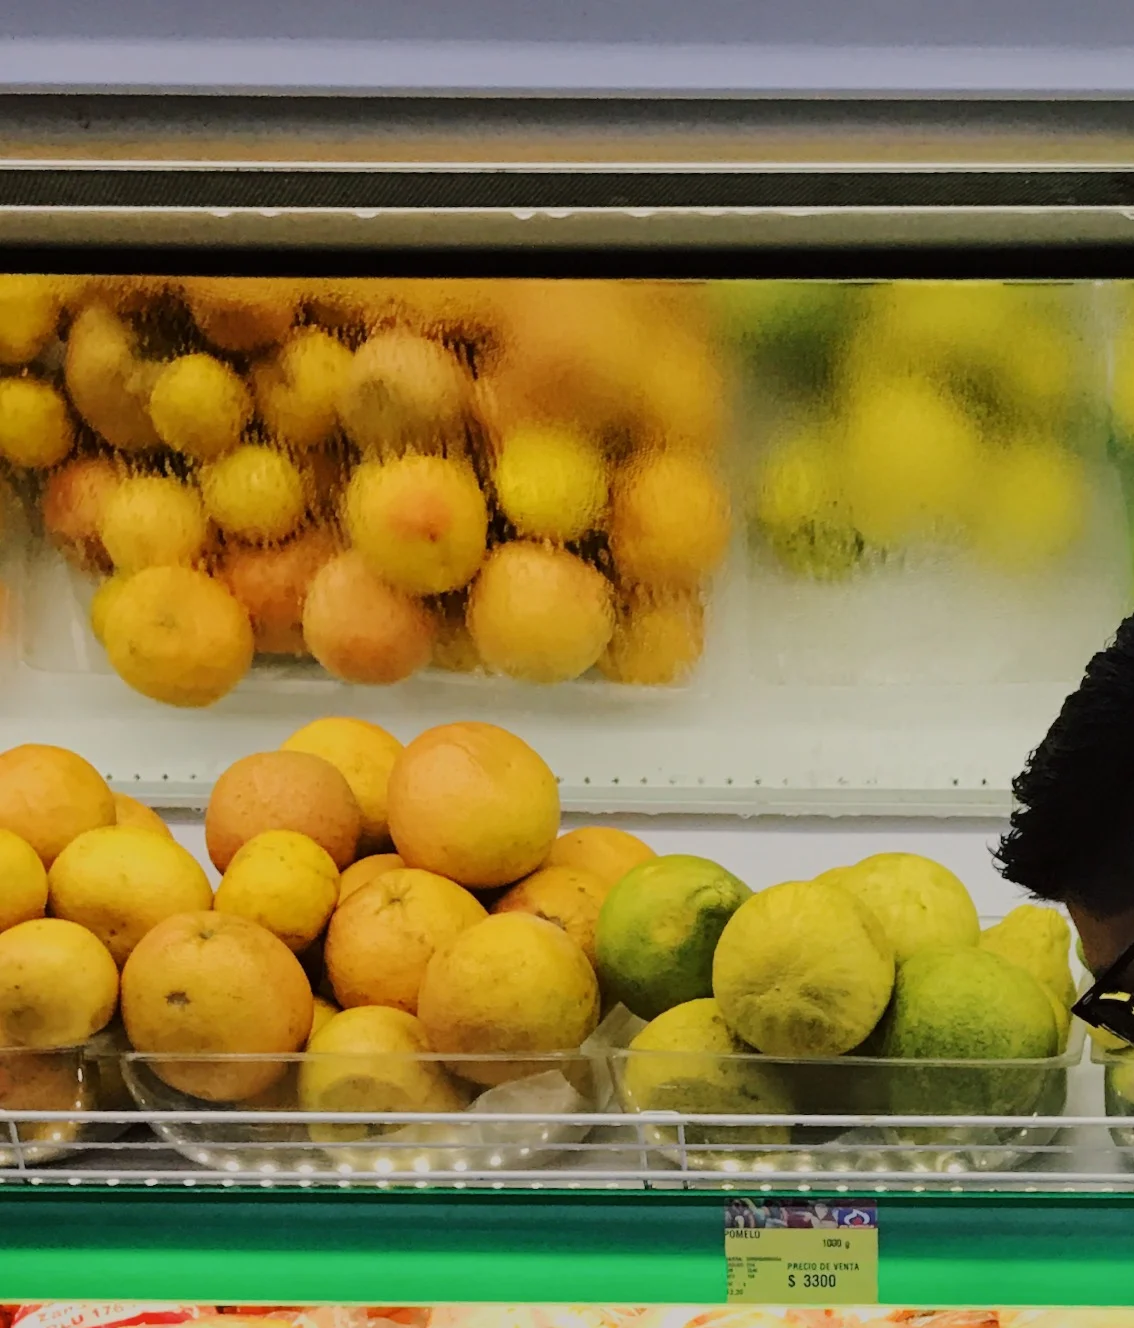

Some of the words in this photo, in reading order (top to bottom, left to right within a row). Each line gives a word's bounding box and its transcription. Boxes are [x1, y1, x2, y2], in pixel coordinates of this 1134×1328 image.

[725, 1230, 760, 1239] POMELO
[787, 1263, 817, 1271] PRECIO
[834, 1263, 860, 1271] VENTA
[788, 1274, 796, 1287] $
[804, 1275, 836, 1287] 3300
